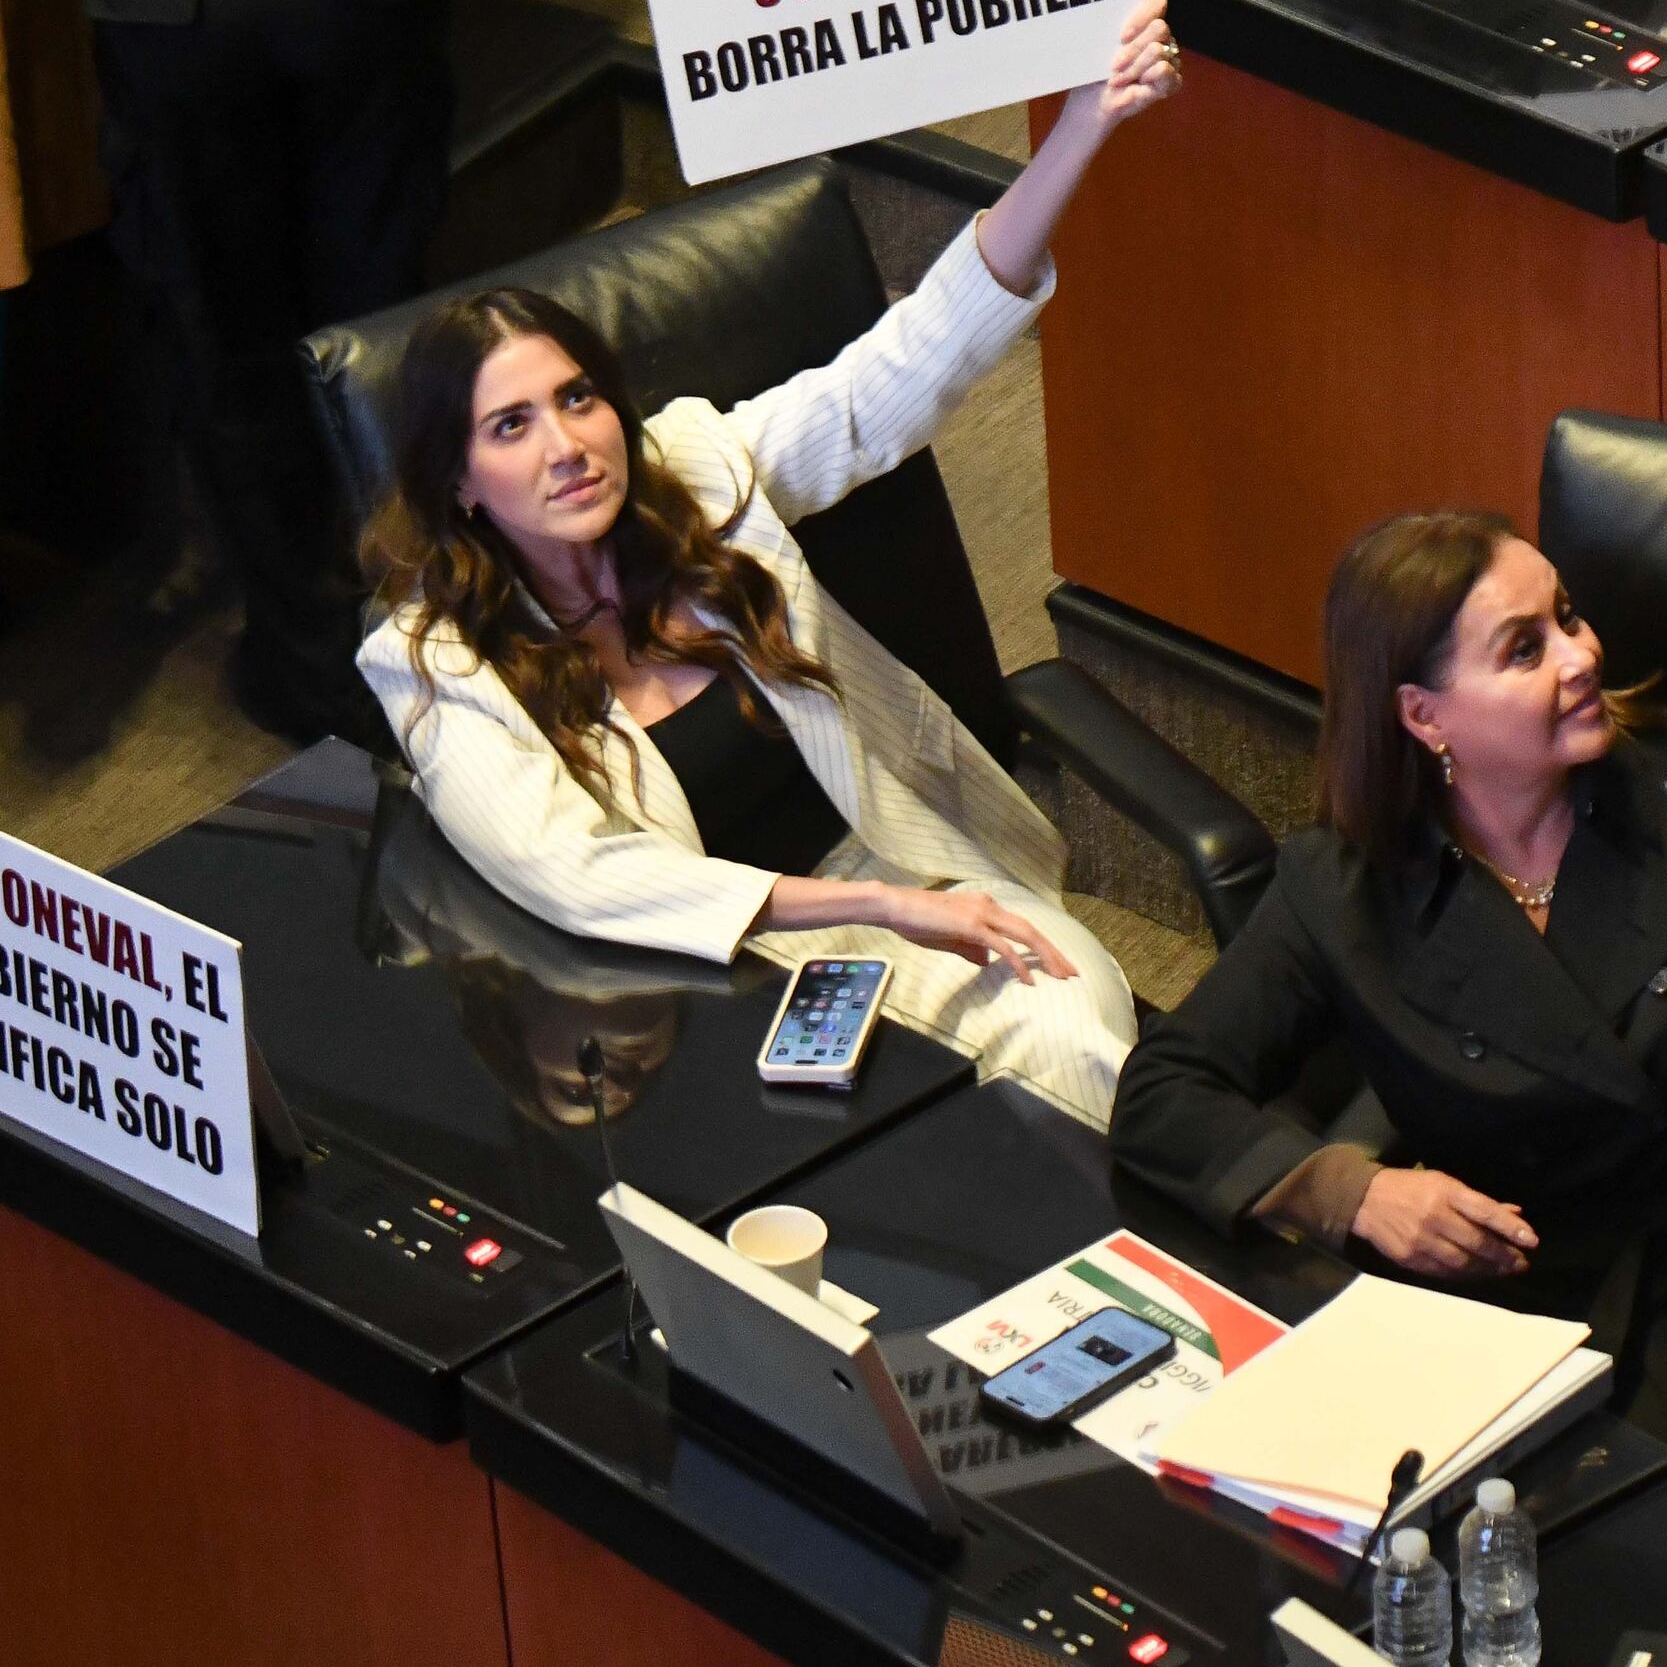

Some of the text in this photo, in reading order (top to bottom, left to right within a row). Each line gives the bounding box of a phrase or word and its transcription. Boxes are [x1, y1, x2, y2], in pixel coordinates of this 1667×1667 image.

[683, 19, 846, 101] BORRA
[851, 3, 909, 60] LA
[2, 868, 228, 1023] ONEVAL, EL
[151, 1017, 204, 1090] SE
[115, 1077, 223, 1175] SOLO
